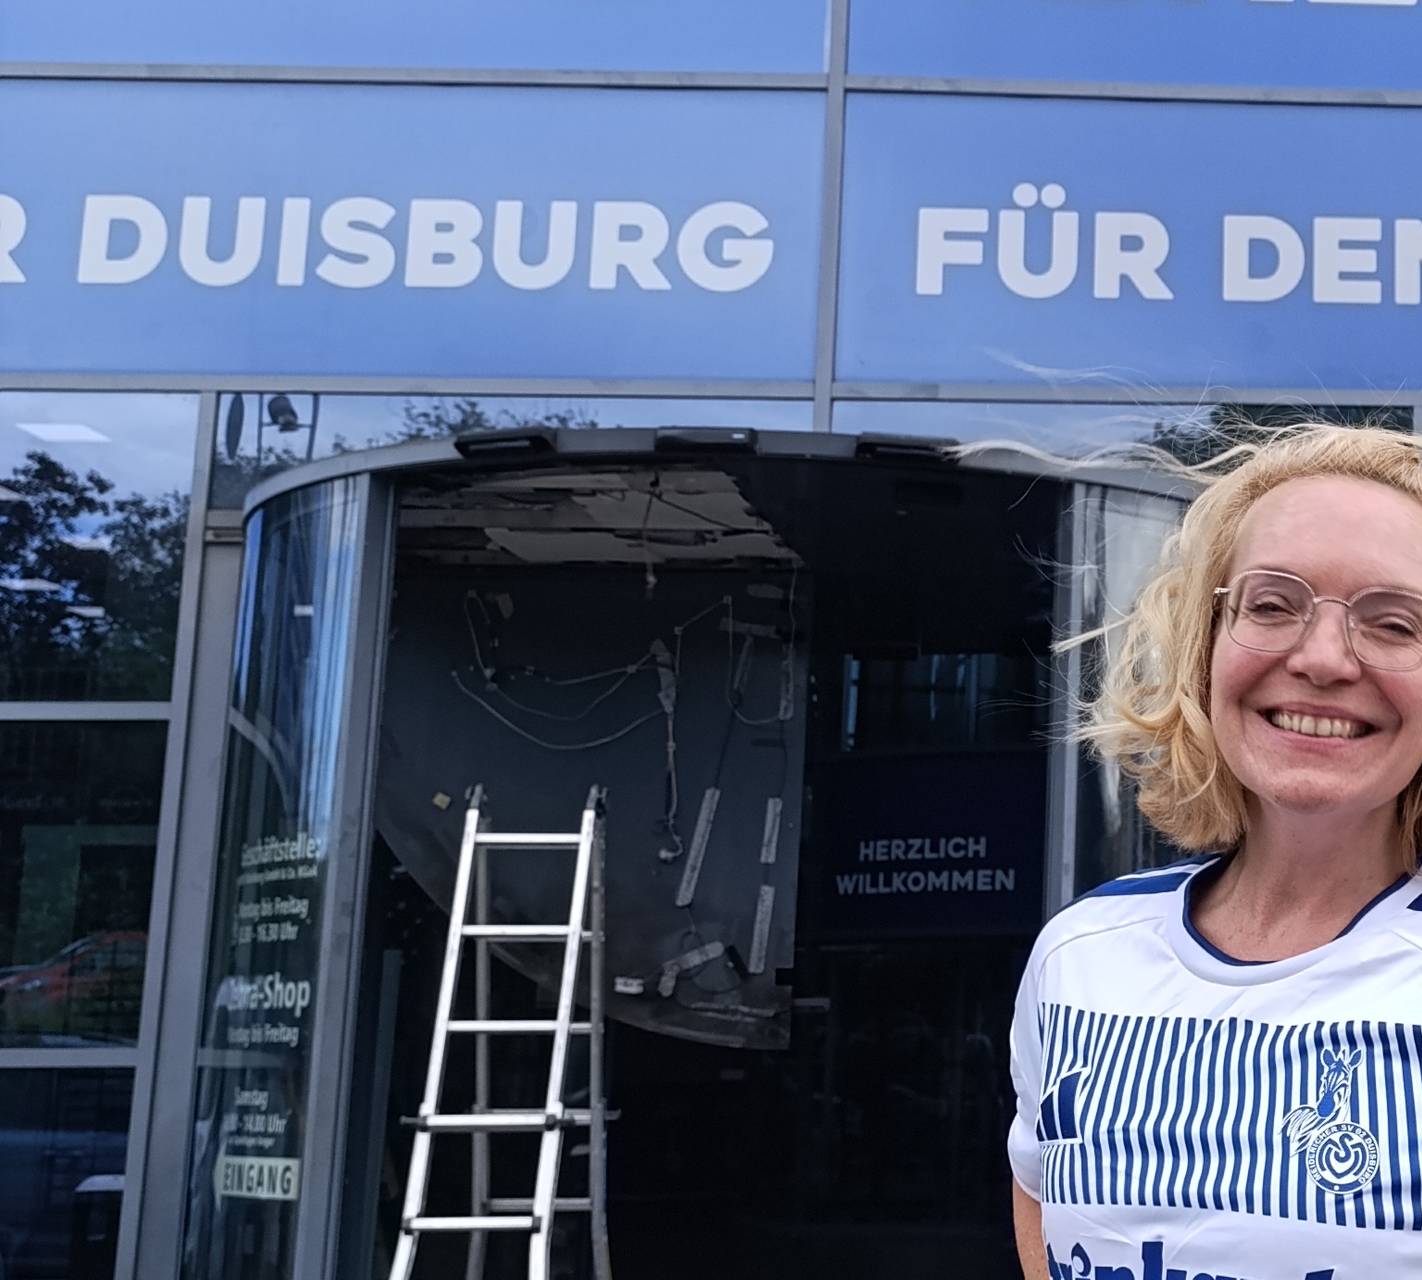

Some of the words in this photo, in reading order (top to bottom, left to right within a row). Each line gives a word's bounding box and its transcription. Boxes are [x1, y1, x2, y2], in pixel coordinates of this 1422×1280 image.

[77, 194, 775, 293] DUISBURG
[915, 182, 1175, 301] FÜR
[858, 835, 987, 862] HERZLICH
[835, 868, 1016, 896] WILLKOMMEN
[222, 1162, 294, 1196] EINGANG
